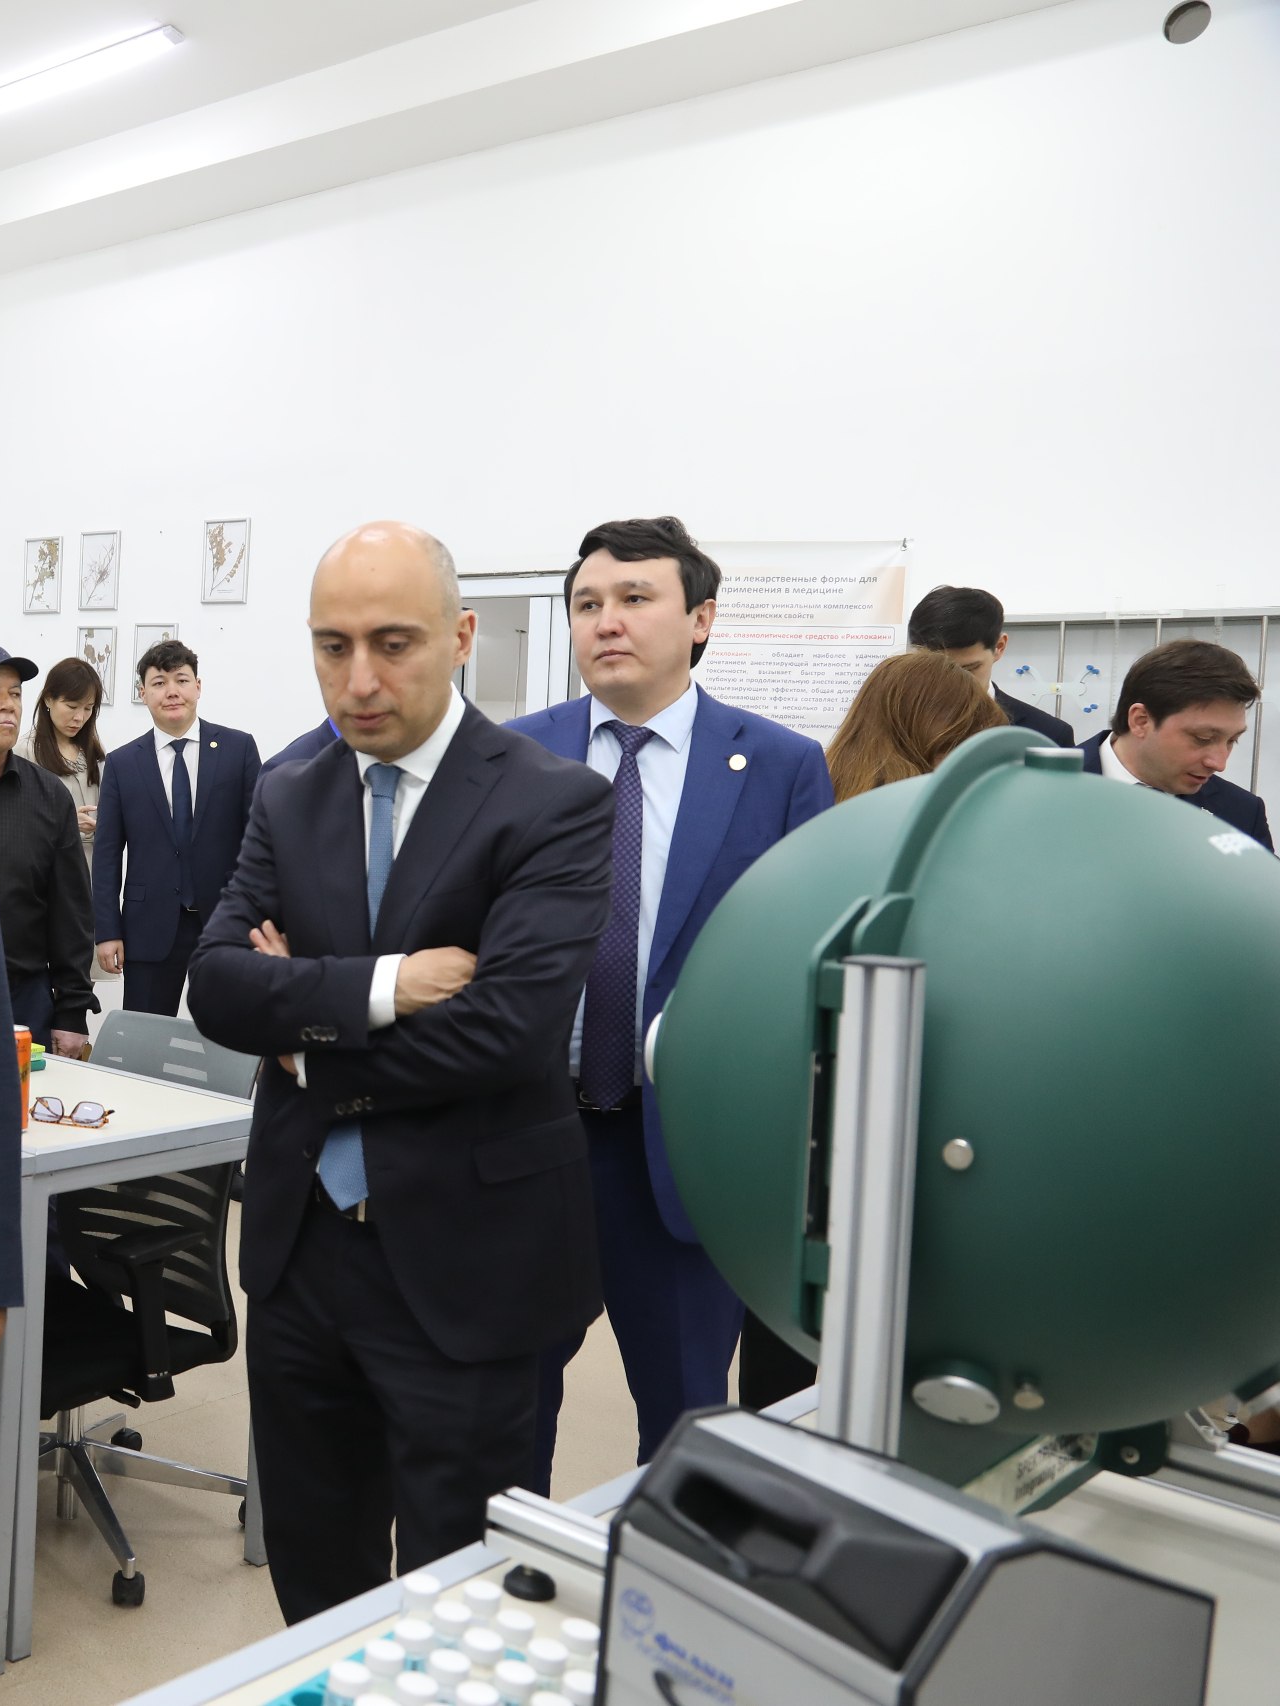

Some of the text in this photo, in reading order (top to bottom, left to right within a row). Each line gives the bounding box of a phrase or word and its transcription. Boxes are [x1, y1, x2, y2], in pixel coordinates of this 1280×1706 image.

[743, 575, 817, 584] лекарственные
[820, 574, 856, 585] формы
[859, 576, 877, 584] для
[721, 587, 782, 595] применения
[792, 587, 843, 595] медицине
[715, 611, 782, 619] биомедицинских
